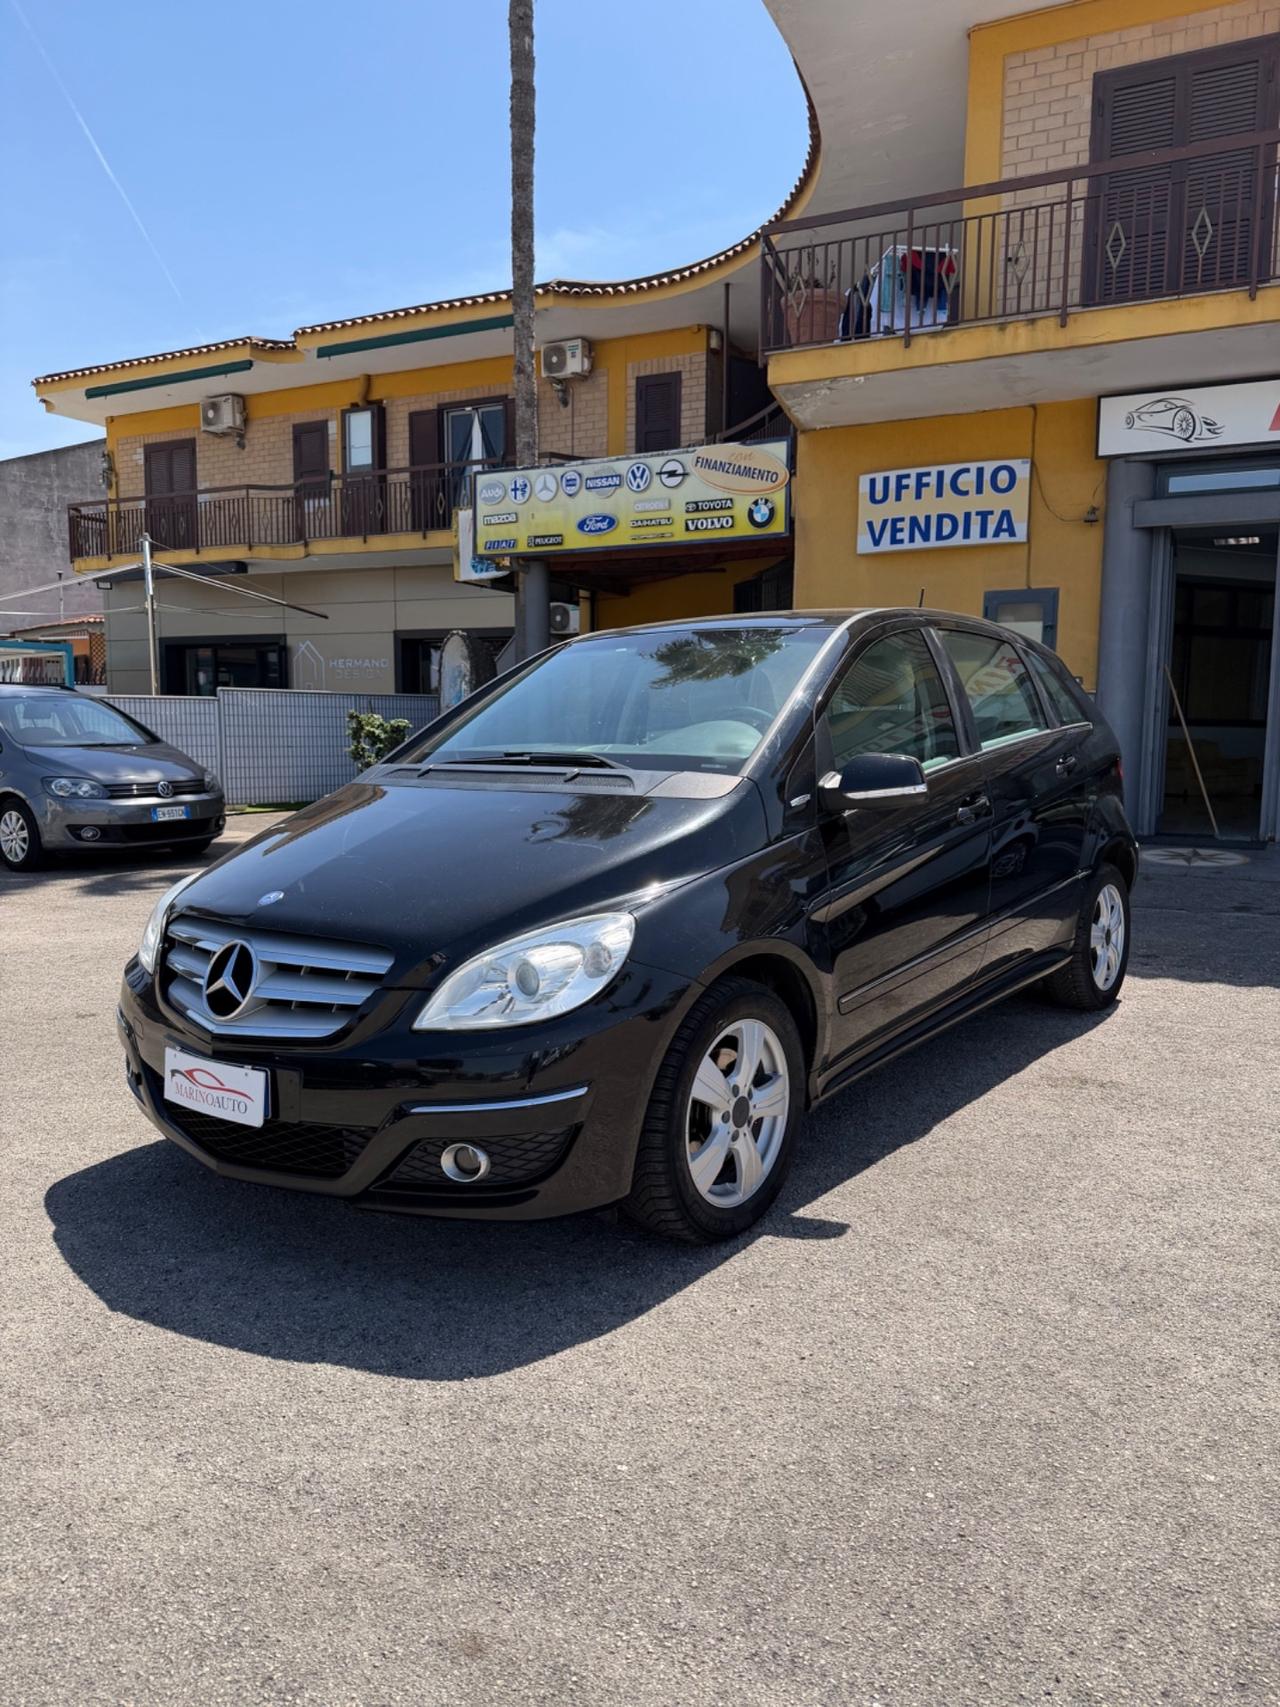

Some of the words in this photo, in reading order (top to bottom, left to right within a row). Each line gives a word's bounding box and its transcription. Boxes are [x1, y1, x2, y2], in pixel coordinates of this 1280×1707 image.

[694, 456, 779, 484] FINANZIAMENTO
[586, 476, 620, 489] NISSAN
[869, 465, 1017, 504] UFFICIO
[698, 500, 733, 511] TOYOTA
[583, 516, 610, 531] Ford
[630, 517, 672, 528] DAIHATSU
[687, 516, 733, 531] VOLVO
[866, 509, 1017, 547] VENDITA
[485, 539, 515, 550] FIAT
[534, 536, 563, 546] PEUGEOT
[175, 1083, 247, 1114] MARINOAUTO
